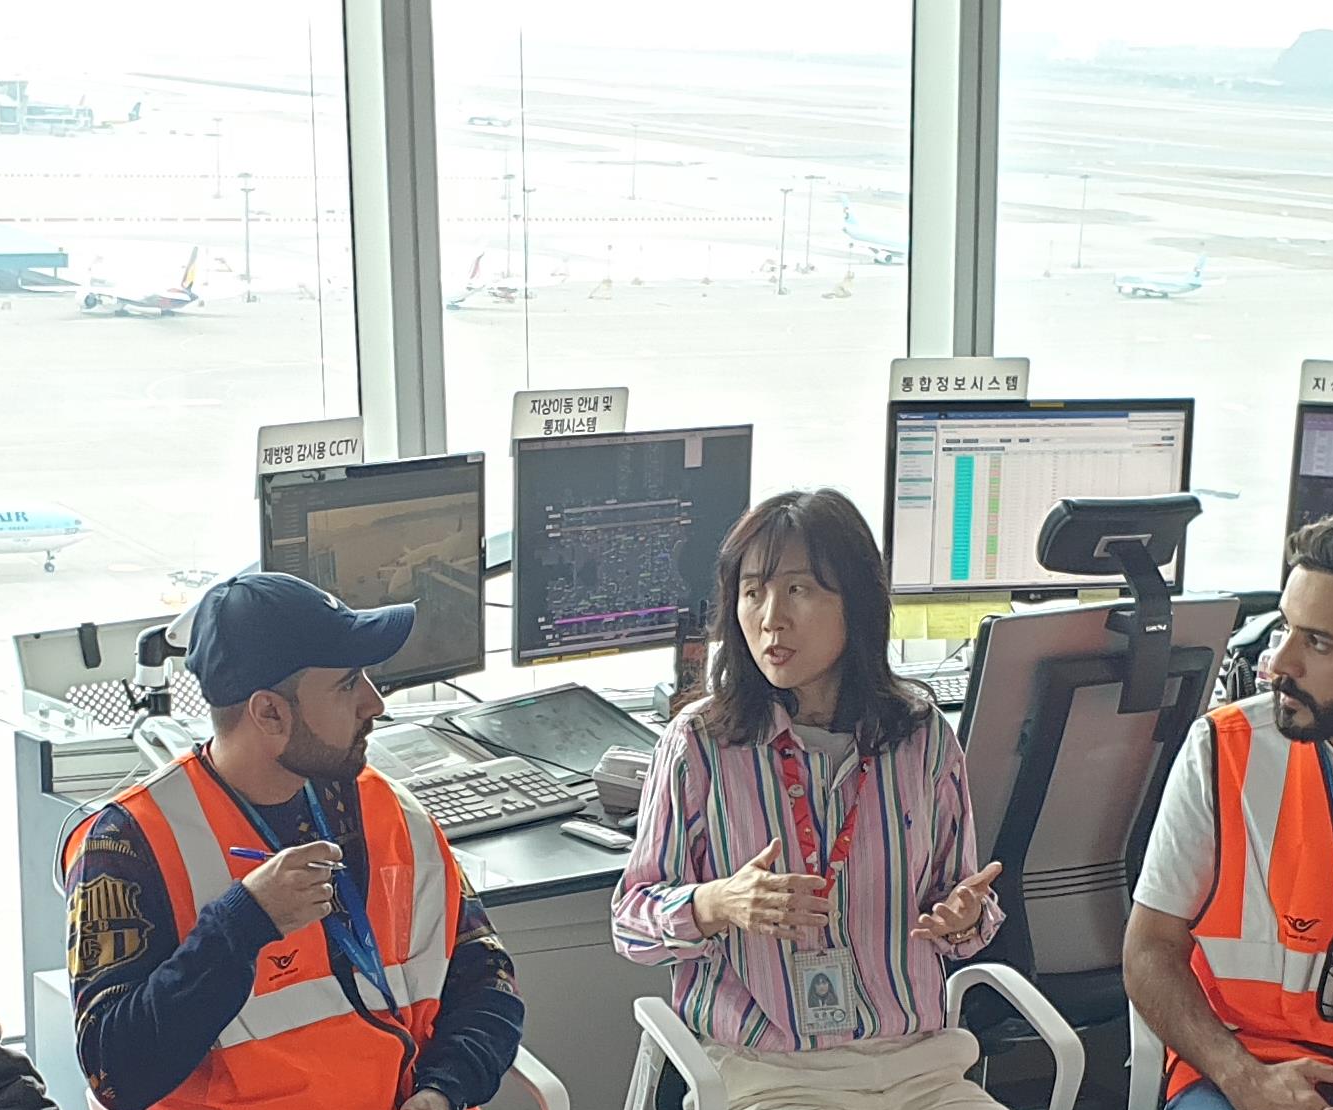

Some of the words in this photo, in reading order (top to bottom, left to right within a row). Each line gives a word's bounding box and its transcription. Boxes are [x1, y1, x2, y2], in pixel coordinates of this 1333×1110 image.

[901, 375, 1018, 393] 통합정보시스템
[530, 397, 574, 416] 지상이동
[577, 395, 599, 414] 안내
[602, 395, 613, 412] 및
[543, 416, 598, 436] 통제시스템
[262, 444, 294, 466] 제방빙
[297, 441, 326, 462] 감시용
[329, 438, 359, 457] CCTV
